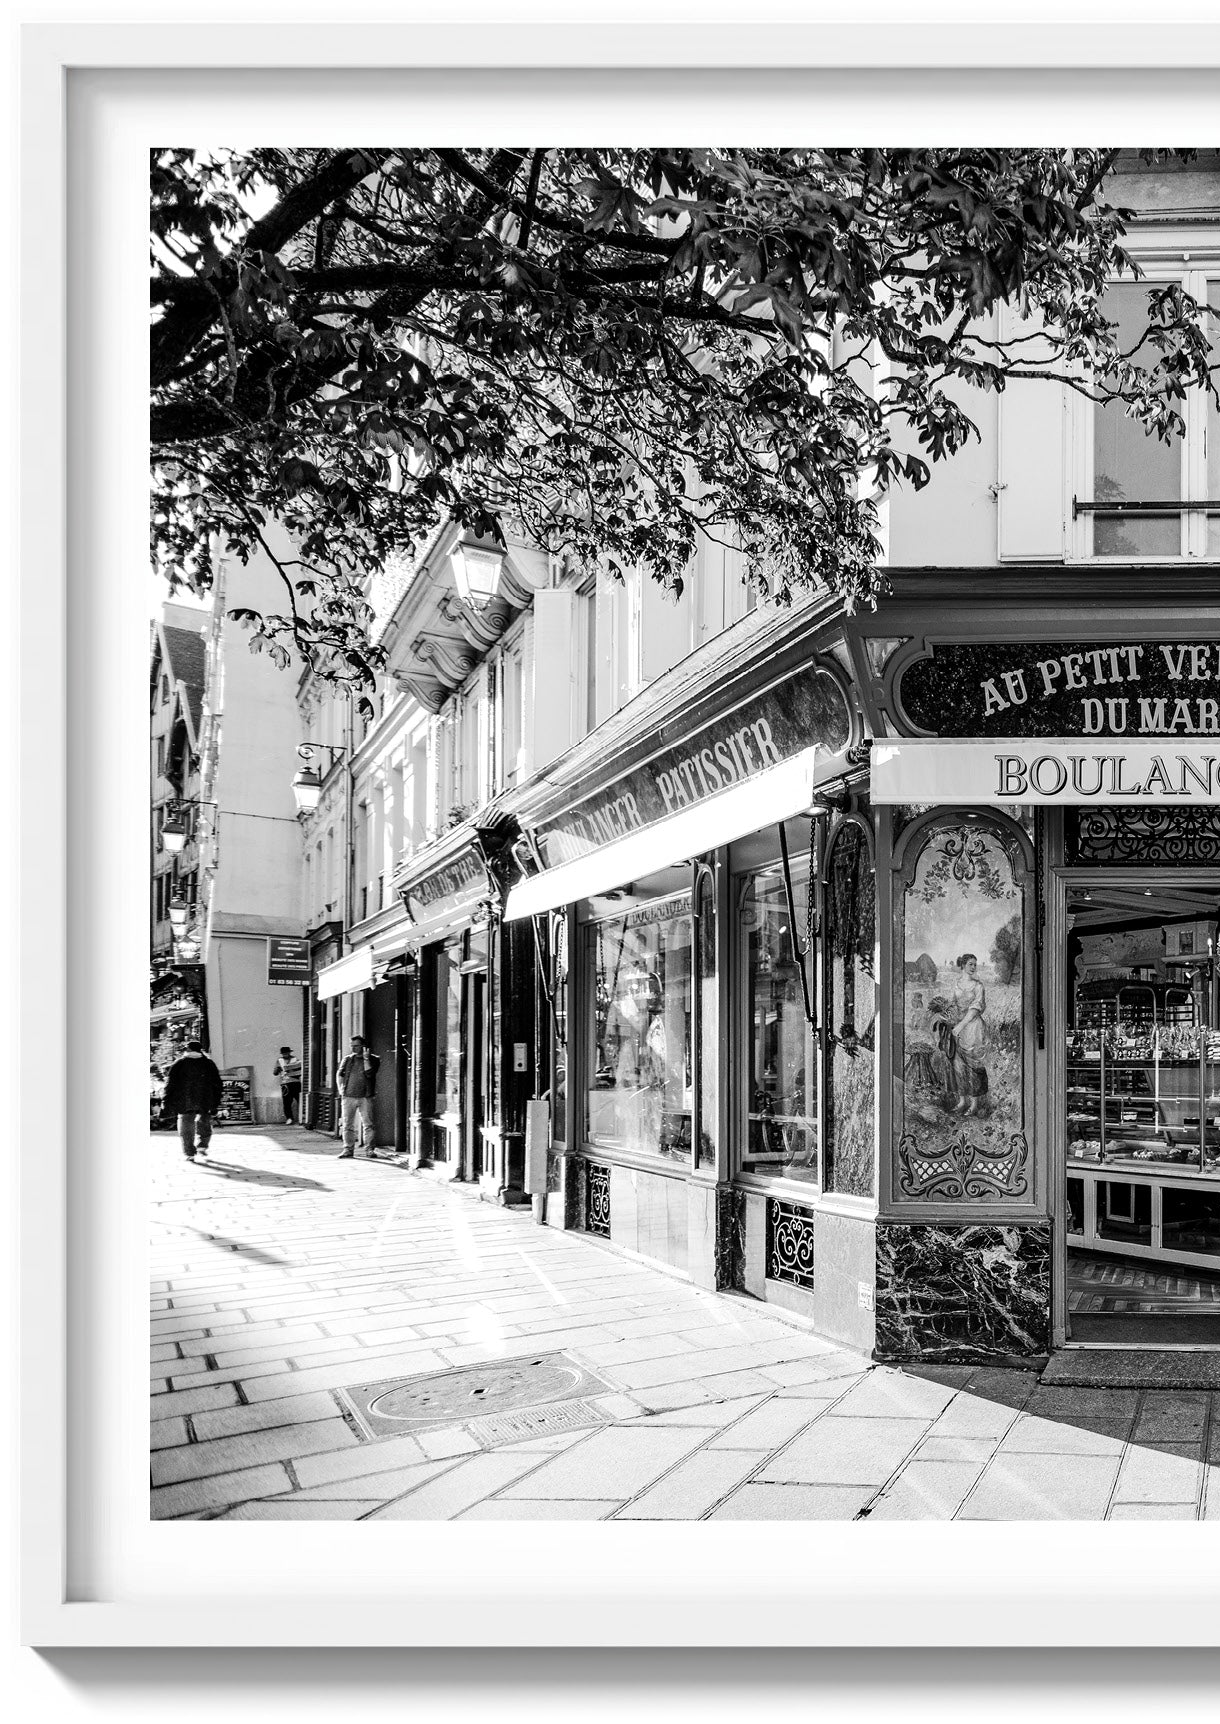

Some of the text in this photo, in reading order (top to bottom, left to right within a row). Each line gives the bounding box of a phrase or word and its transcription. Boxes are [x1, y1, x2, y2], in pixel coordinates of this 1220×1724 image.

[980, 669, 1029, 717] AU
[1036, 645, 1144, 696] PETIT
[1081, 698, 1130, 734] DU
[655, 717, 784, 815] PATISSIER
